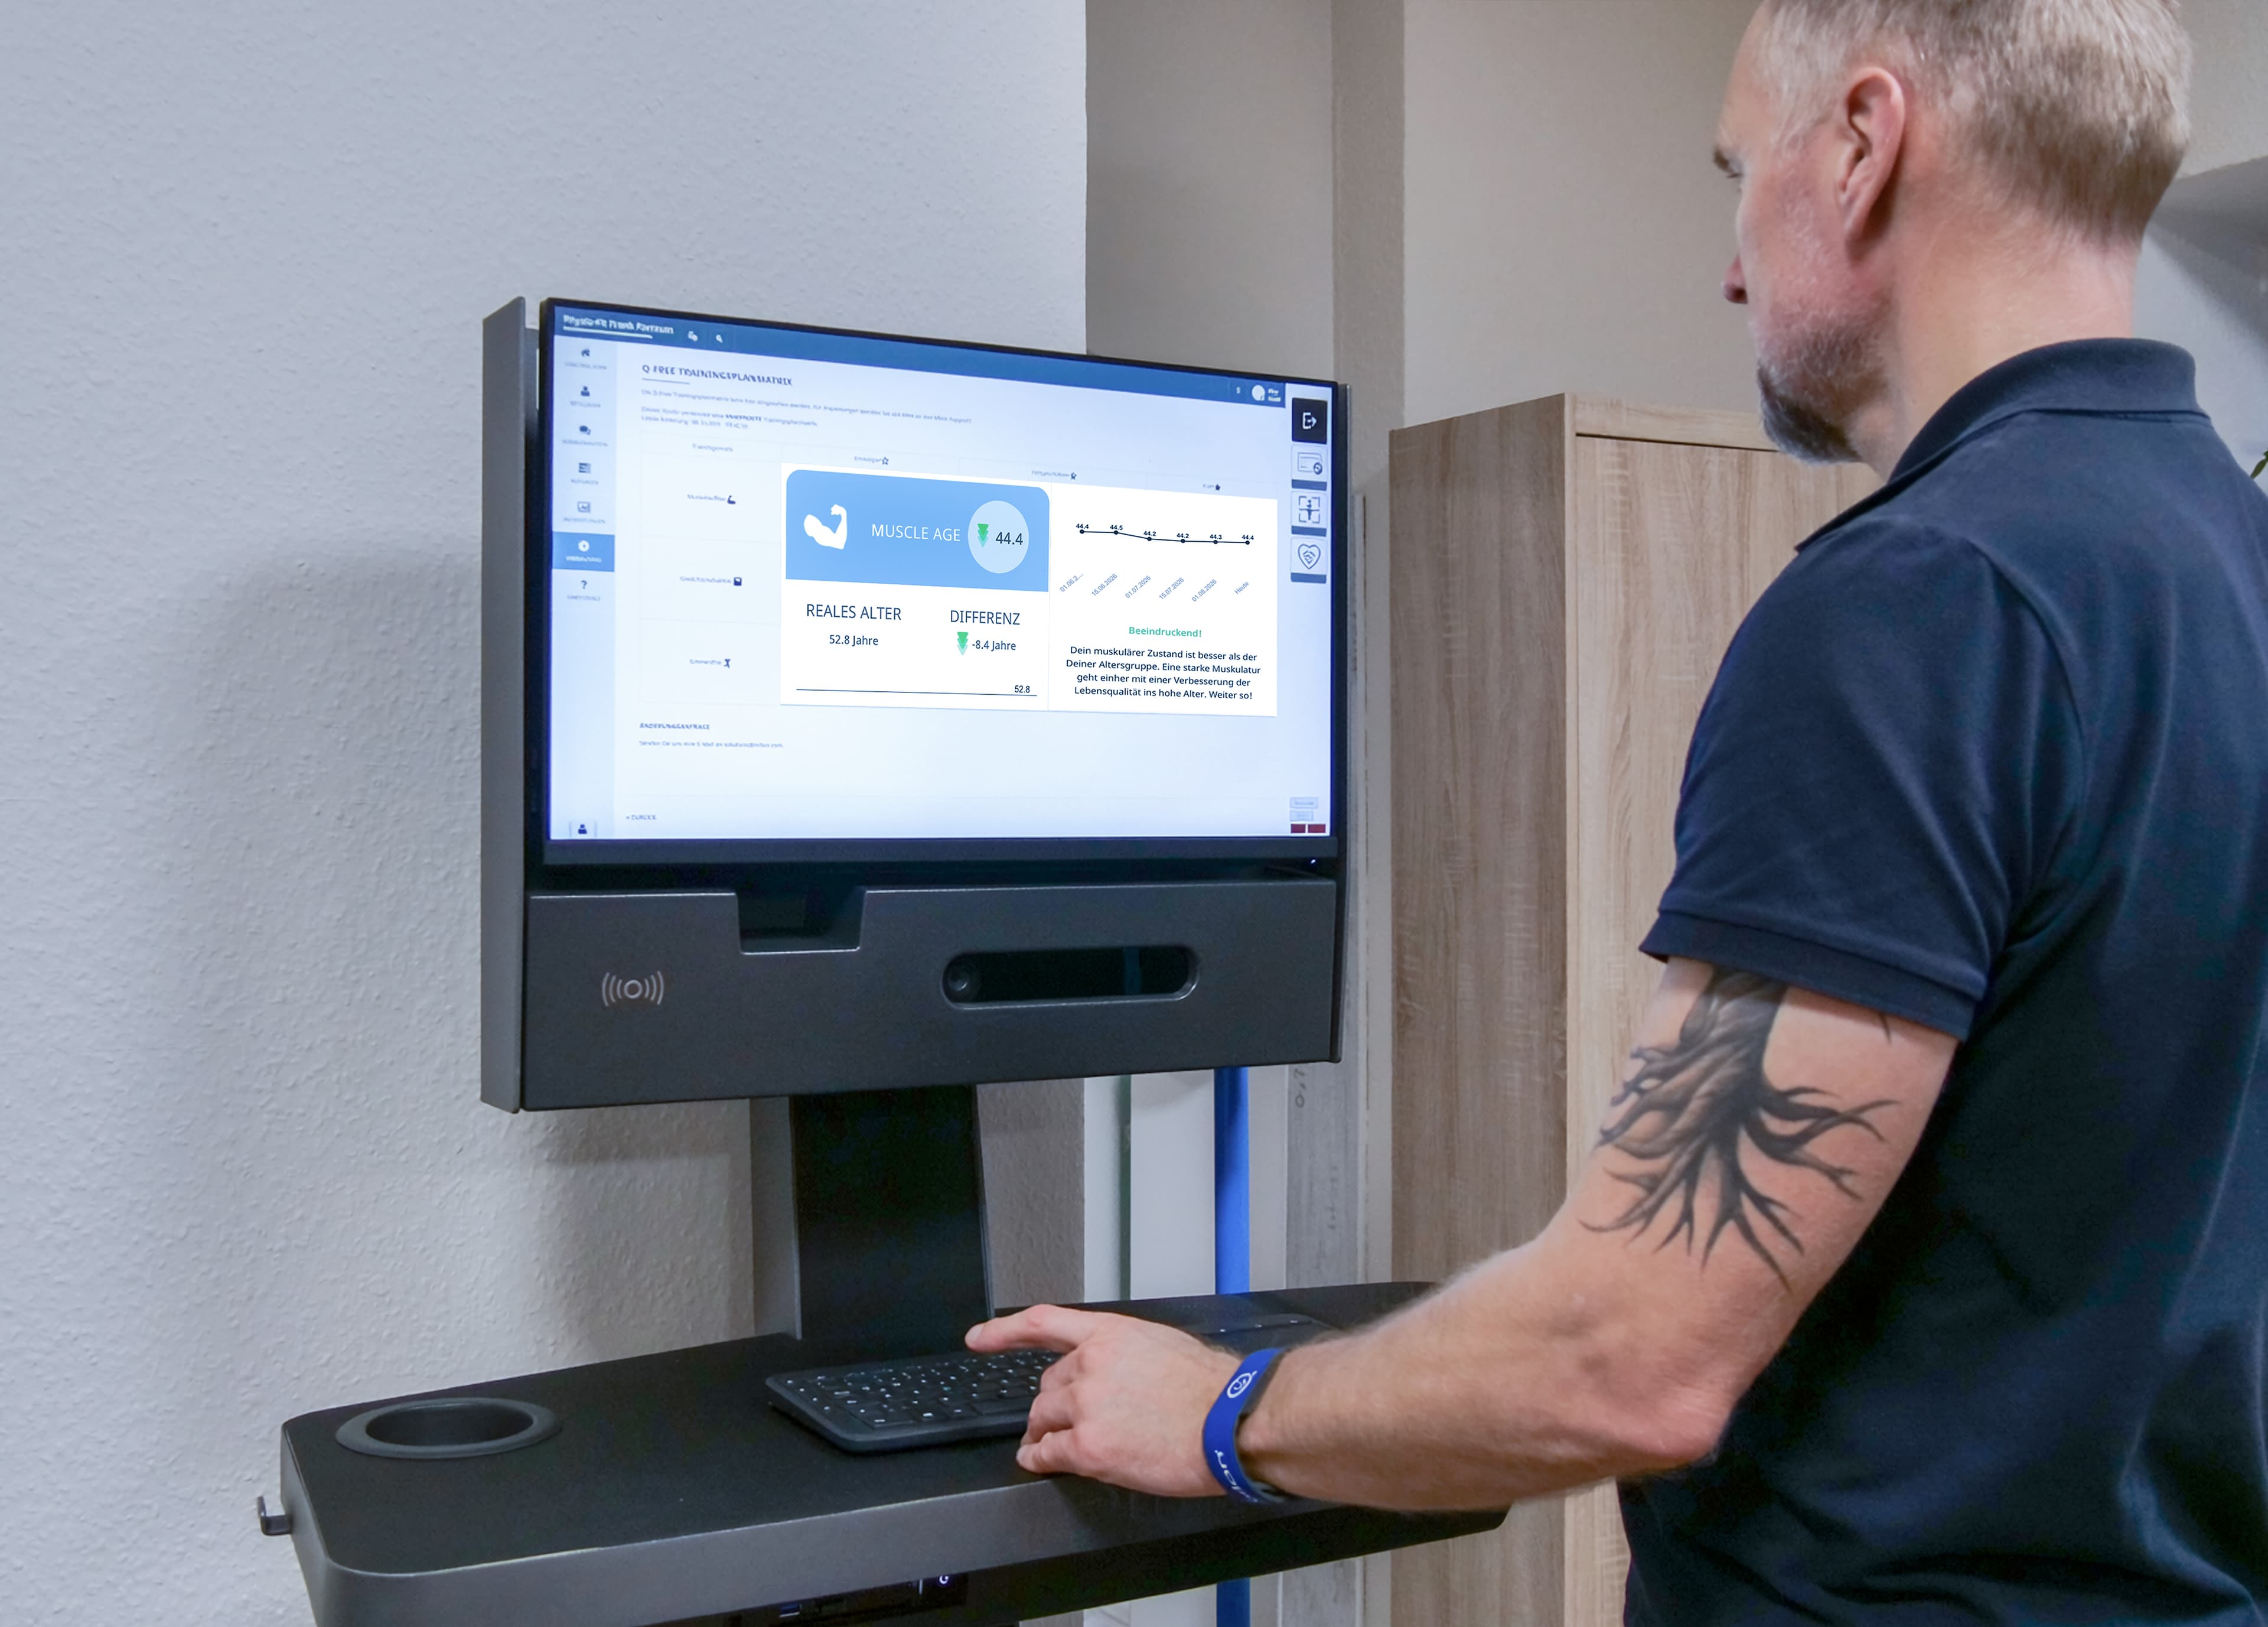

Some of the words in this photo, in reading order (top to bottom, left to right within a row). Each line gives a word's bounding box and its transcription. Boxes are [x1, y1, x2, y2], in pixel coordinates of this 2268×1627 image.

[872, 523, 928, 539] MUSCLE
[933, 528, 960, 542] AGE
[995, 531, 1024, 545] 44.4
[1091, 573, 1118, 596] 15.06.2026
[1125, 575, 1151, 599] 01.07.2026
[1159, 577, 1185, 600] 15.07.2026
[1191, 578, 1217, 602] 01.08.2026
[1234, 581, 1249, 595] Heute
[807, 604, 856, 619] REALES
[859, 606, 902, 620] ALTER
[950, 610, 1021, 626] DIFFERENZ
[1129, 626, 1202, 637] Beeindruckend!
[829, 634, 850, 645] 52.8
[851, 635, 879, 647] Jahre
[972, 640, 990, 650] -8.4
[990, 640, 1016, 652] Jahre
[1070, 646, 1091, 655] Dein
[1094, 647, 1145, 657] muskulärer
[1147, 649, 1183, 658] Zustand
[1185, 650, 1196, 659] ist
[1198, 651, 1227, 660] besser
[1228, 652, 1241, 660] als
[1242, 653, 1257, 661] der
[1066, 659, 1097, 668] Deiner
[1099, 660, 1160, 672] Altersgruppe.
[1162, 663, 1181, 671] Eine
[1183, 664, 1210, 672] starke
[1212, 665, 1261, 674] Muskulatur
[1077, 673, 1098, 683] geht
[1100, 674, 1130, 682] einher
[1132, 675, 1147, 684] mit
[1148, 675, 1172, 684] einer
[1173, 676, 1234, 688] Verbesserung
[1236, 678, 1251, 686] der
[1014, 685, 1031, 694] 52.8
[1074, 686, 1142, 697] Lebensqualität
[1143, 688, 1156, 697] ins
[1158, 689, 1181, 698] hohe
[1182, 689, 1207, 698] Alter.
[1208, 691, 1237, 699] Weiter
